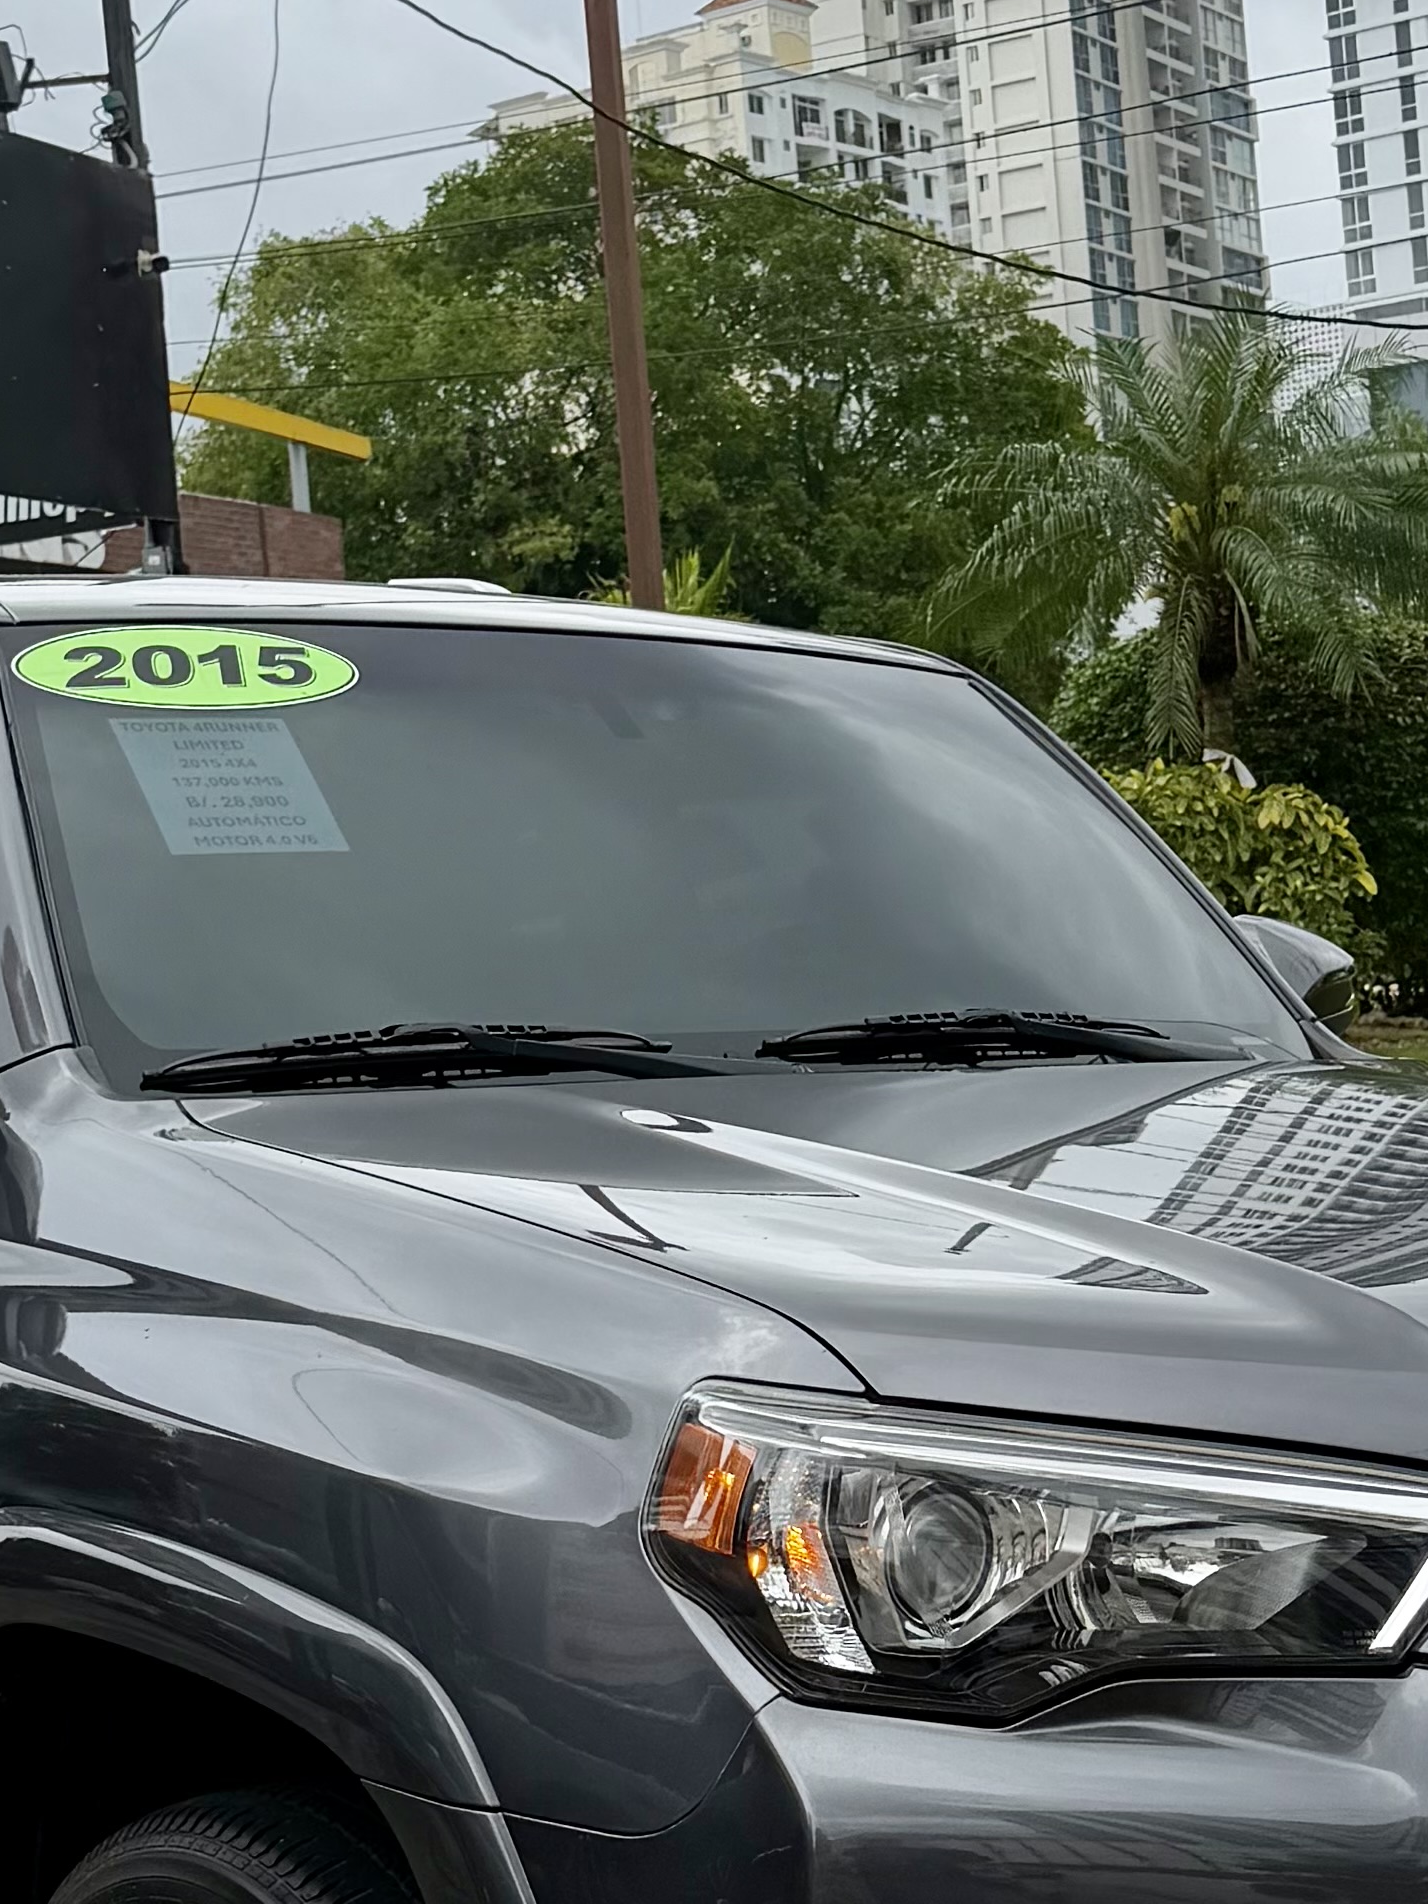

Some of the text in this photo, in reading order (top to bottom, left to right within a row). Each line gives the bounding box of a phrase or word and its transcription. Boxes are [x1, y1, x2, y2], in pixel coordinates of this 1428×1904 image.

[63, 643, 317, 690] 2015
[120, 721, 280, 733] TOYOTA 4RUNNER
[173, 739, 245, 751] LIMITED
[179, 757, 221, 769] 2015
[244, 776, 284, 787] KMS
[188, 814, 307, 829] AUTOMÁTICO
[194, 835, 263, 848] MOTOR
